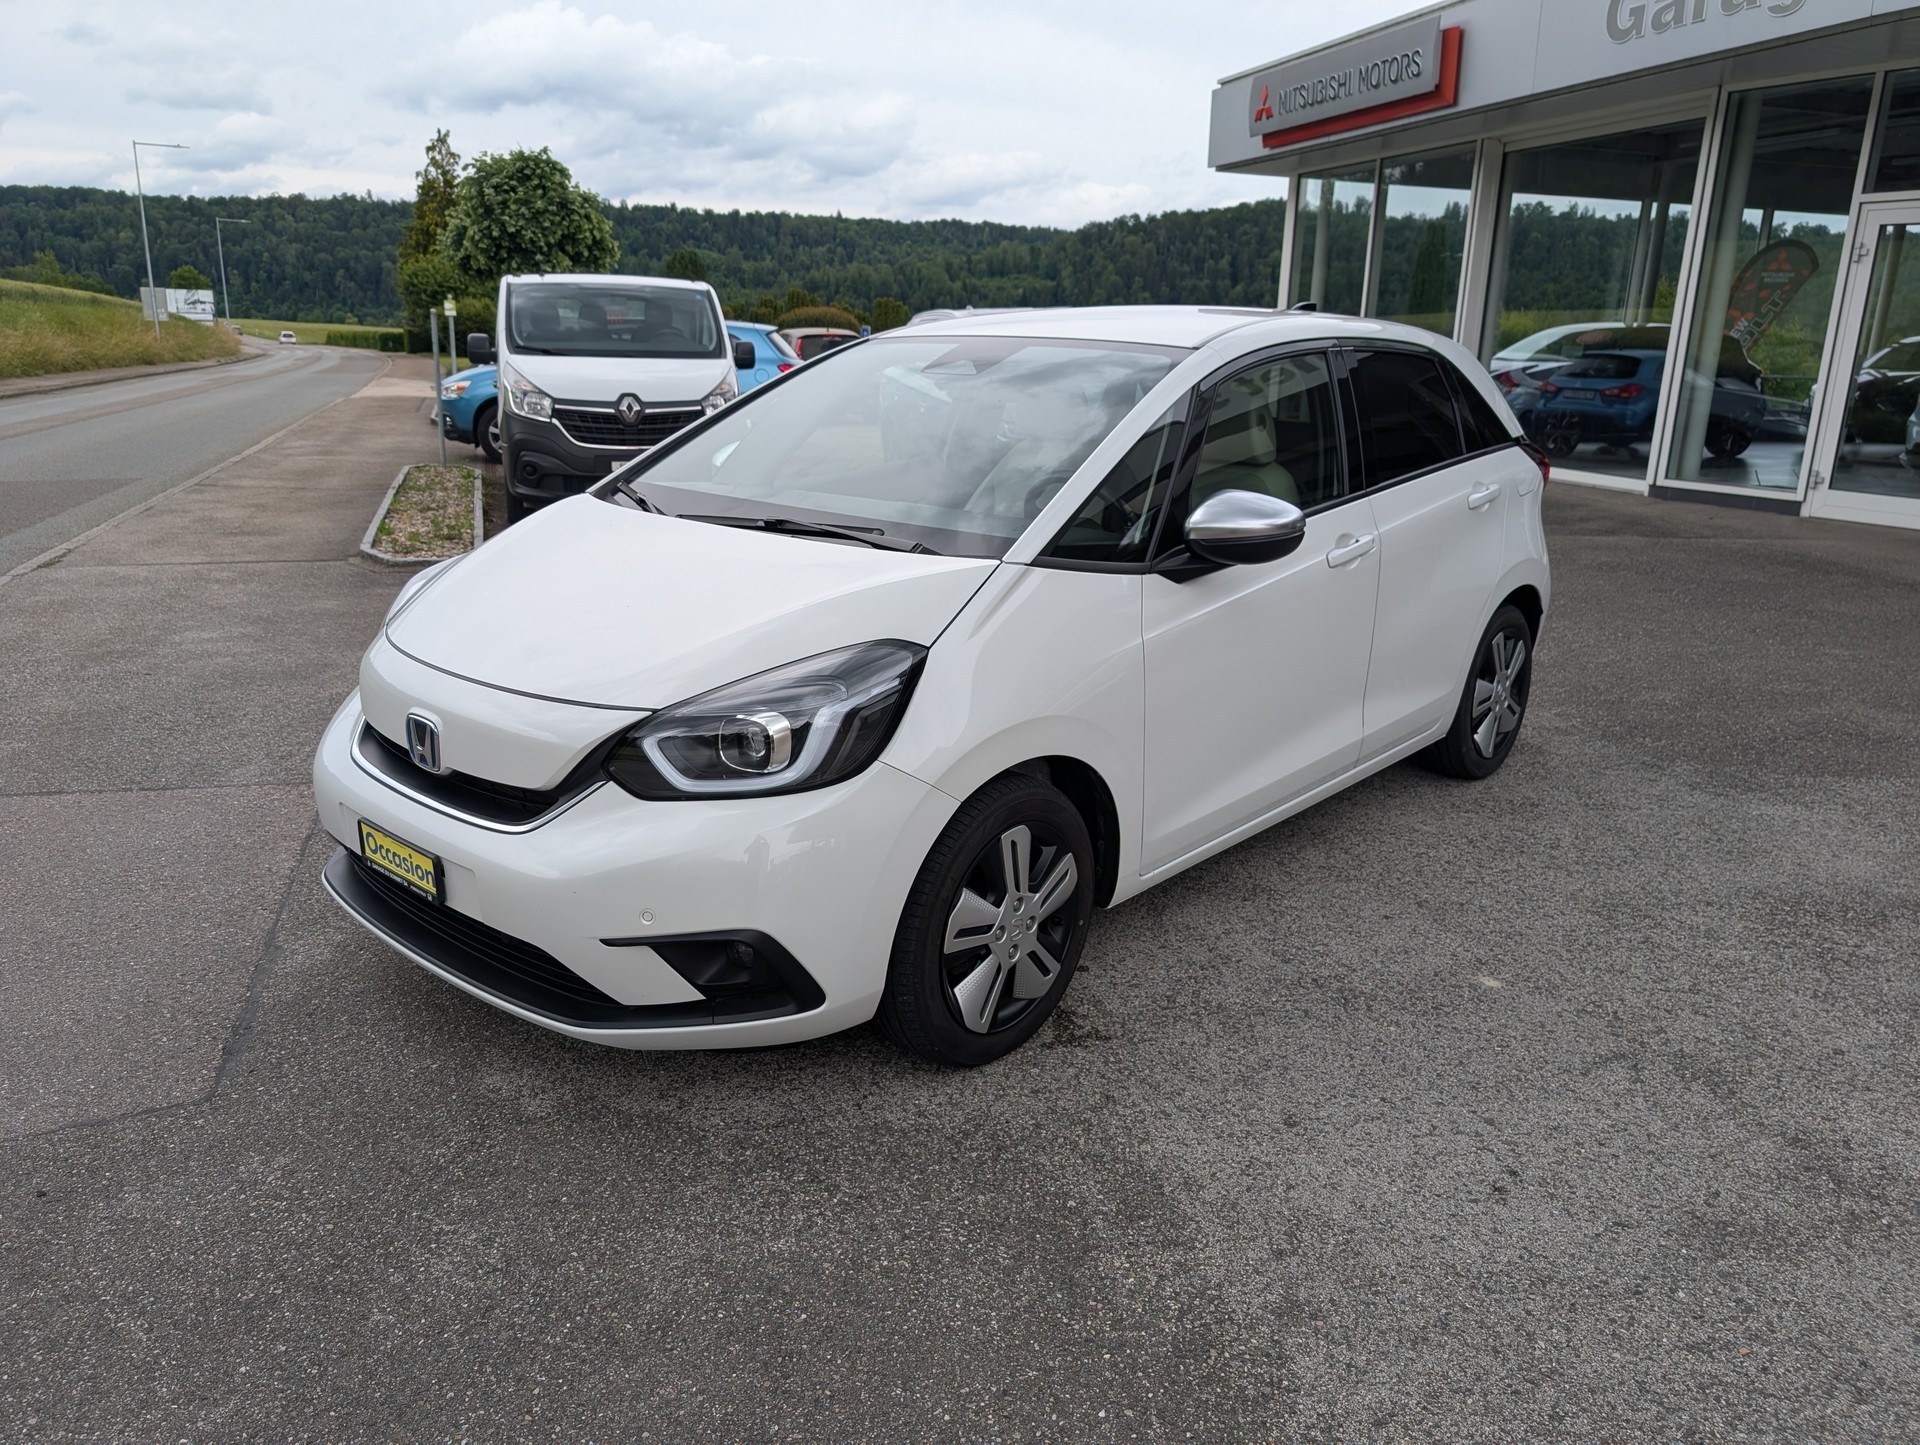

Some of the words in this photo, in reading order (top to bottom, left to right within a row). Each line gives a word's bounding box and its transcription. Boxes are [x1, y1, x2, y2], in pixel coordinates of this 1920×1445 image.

[1278, 67, 1354, 115] MITSUBISHI
[1358, 48, 1422, 93] MOTORS
[1729, 317, 1748, 339] EW
[1740, 290, 1783, 349] OLT
[365, 831, 436, 888] Occasion
